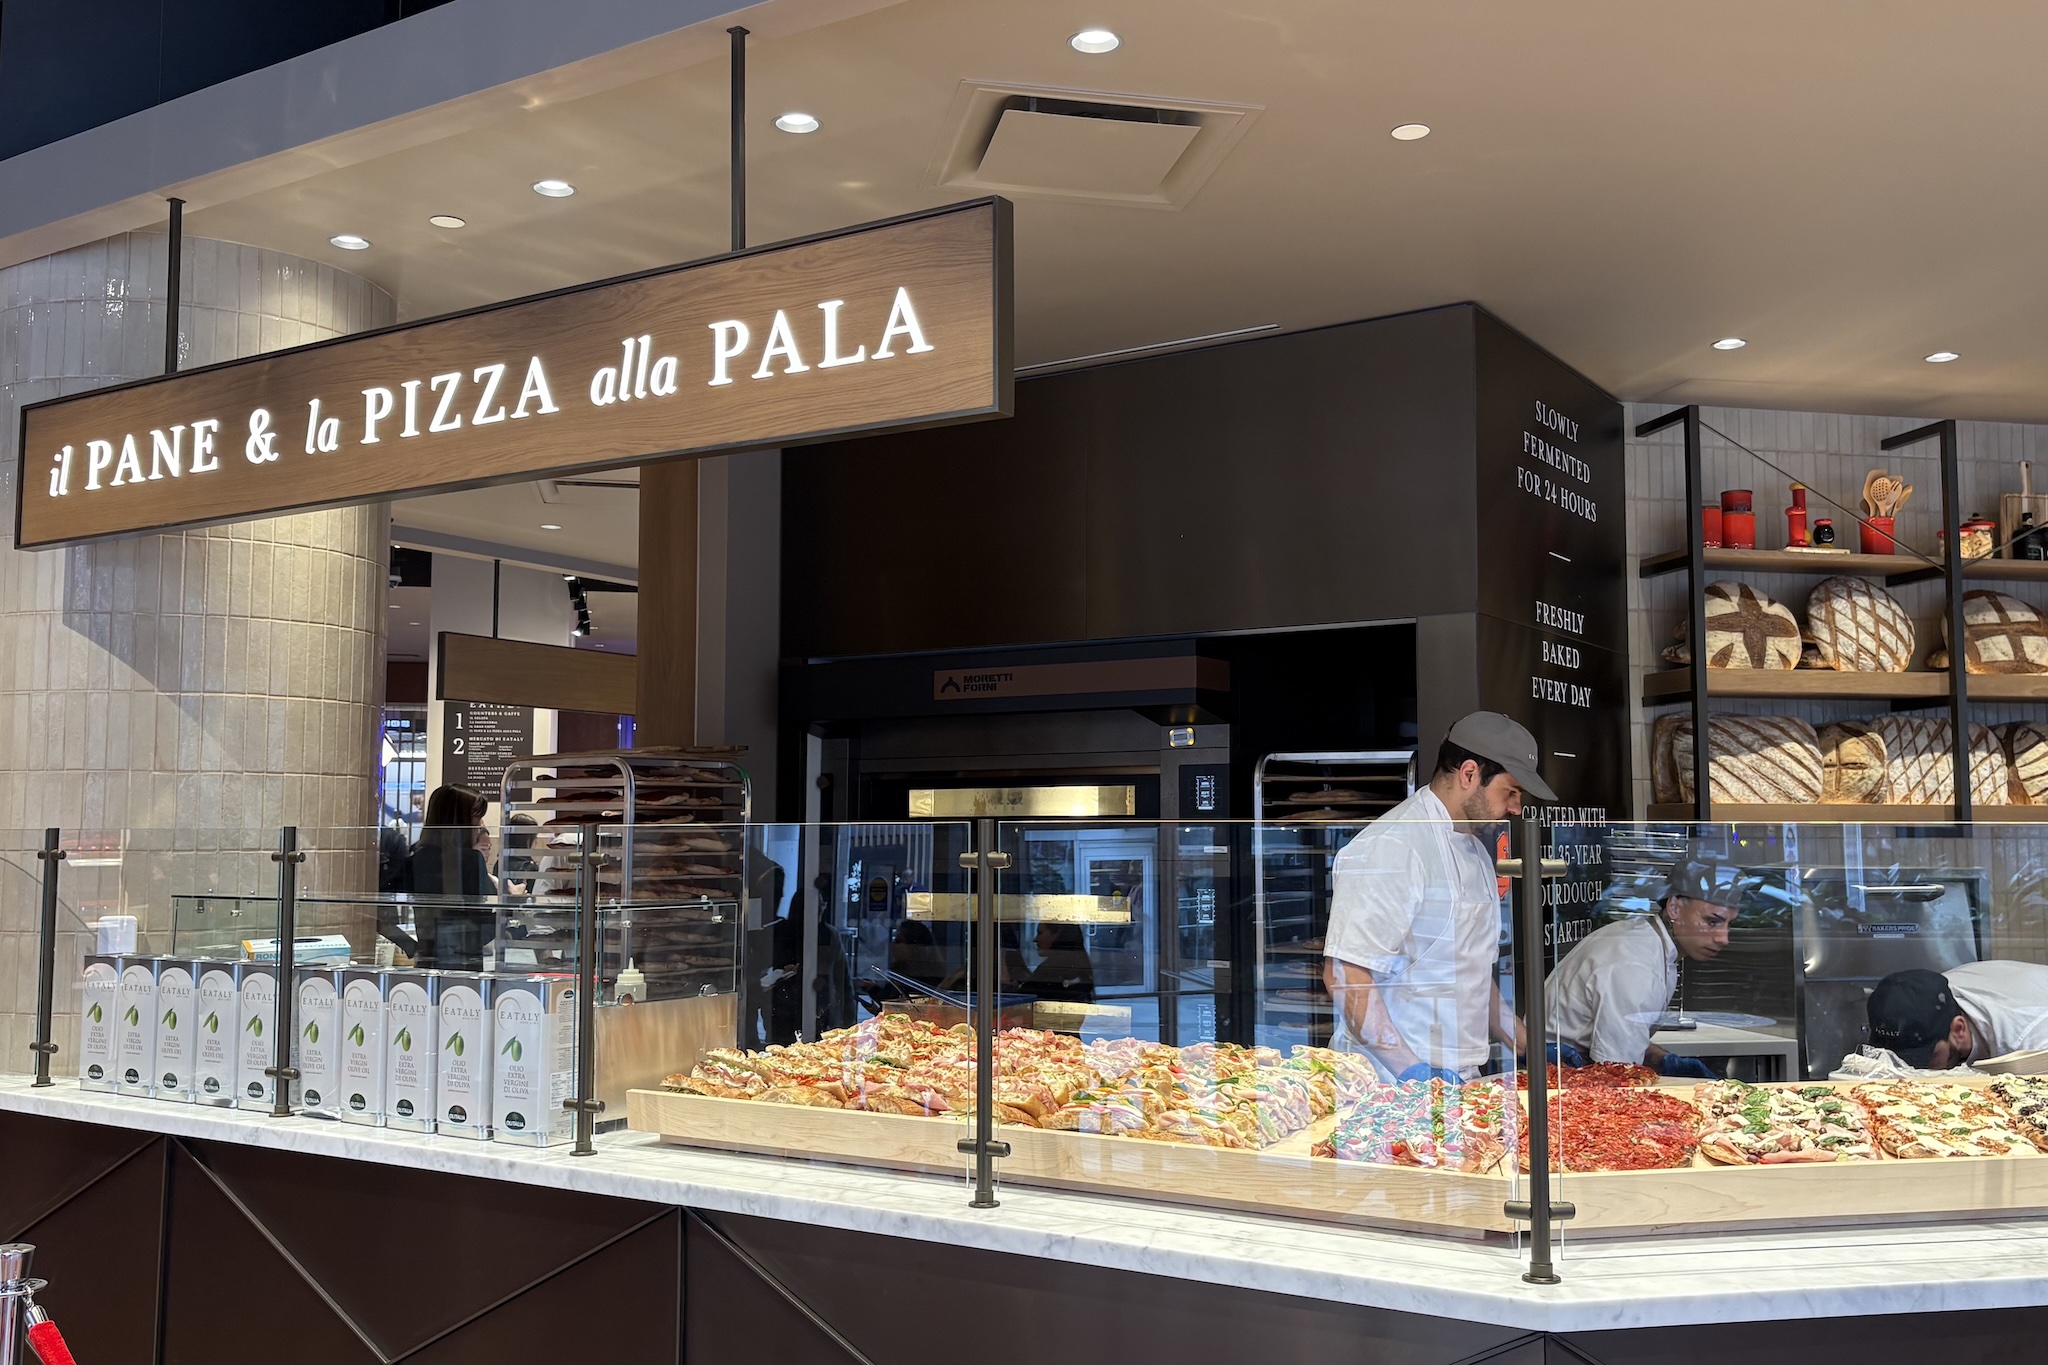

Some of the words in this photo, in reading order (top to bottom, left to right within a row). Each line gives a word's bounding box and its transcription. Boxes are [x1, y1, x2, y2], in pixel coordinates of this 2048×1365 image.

[49, 444, 72, 498] il
[84, 418, 220, 492] PANE
[245, 408, 280, 465] &
[305, 398, 339, 455] la
[360, 356, 560, 446] PIZZA
[590, 334, 679, 407] alla
[708, 286, 934, 387] PALA
[1535, 400, 1579, 443] SLOWLY
[1523, 430, 1590, 484] FERMENTED
[1517, 466, 1541, 497] FOR
[1545, 479, 1557, 504] 24
[1560, 487, 1597, 523] HOURS
[1536, 600, 1584, 635] FRESHLY
[1542, 640, 1580, 669] BAKED
[963, 673, 1013, 683] MORETTI
[963, 683, 997, 692] FORNI
[1532, 676, 1568, 703] EVERY
[1571, 684, 1592, 708] DAY
[455, 712, 464, 730] 1
[453, 738, 465, 755] 2
[1578, 807, 1606, 828] WITH
[1558, 844, 1602, 866] 35-YEAR
[124, 984, 152, 993] EATALY
[162, 987, 191, 995] EATALY
[203, 990, 232, 998] EATALY
[302, 998, 334, 1006] EATALY
[347, 1000, 379, 1009] EATALY
[393, 1003, 427, 1013] EATALY
[444, 1007, 481, 1017] EATALY
[500, 1011, 540, 1021] EATALY
[503, 1079, 529, 1087] VERGINE
